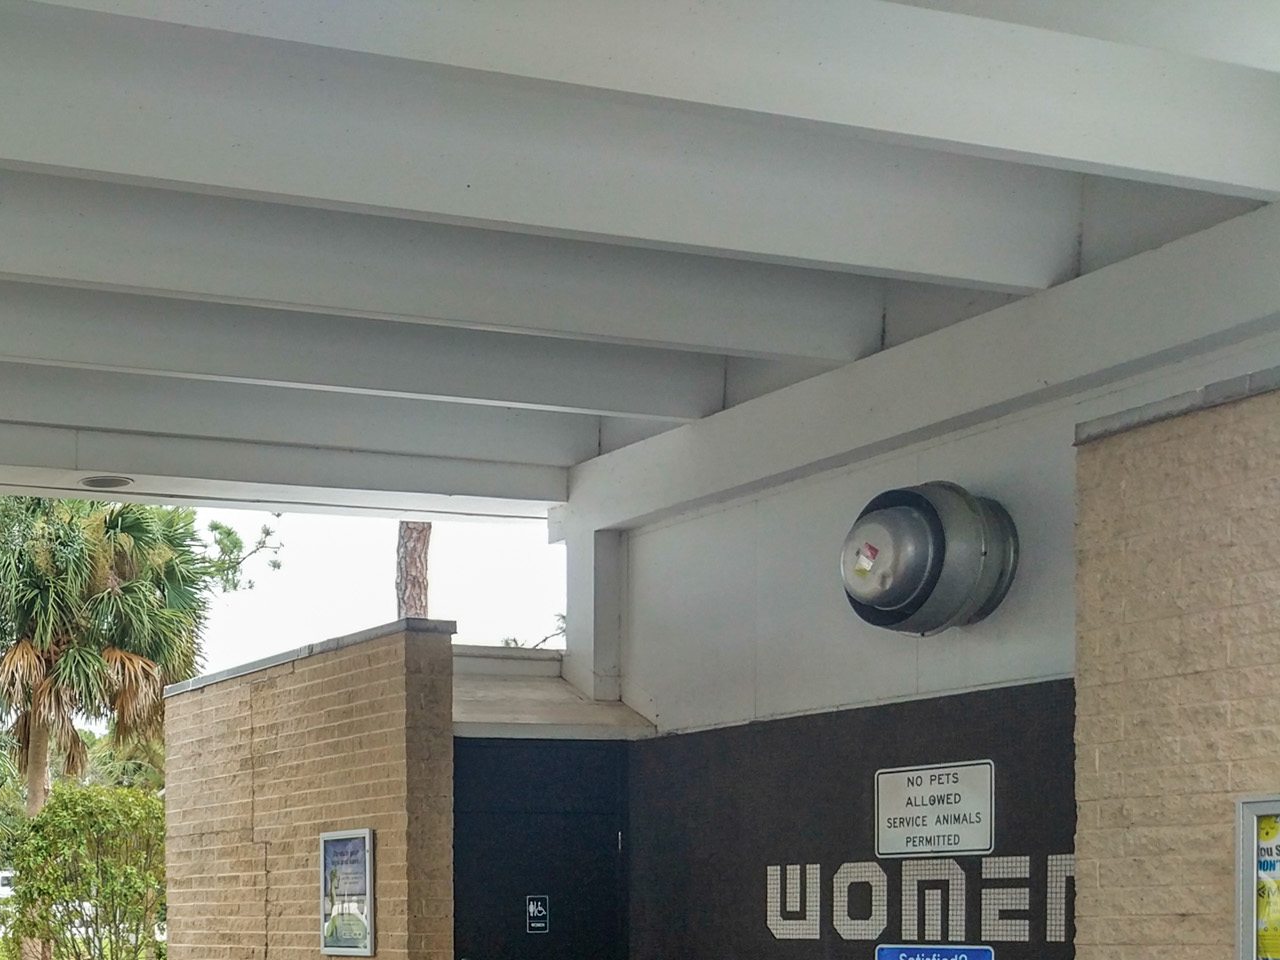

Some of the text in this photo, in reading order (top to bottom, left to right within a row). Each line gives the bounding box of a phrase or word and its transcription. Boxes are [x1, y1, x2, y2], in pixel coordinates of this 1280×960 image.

[907, 772, 959, 787] NO PETS
[905, 793, 962, 808] ALLOWED
[886, 812, 982, 829] SERVICE ANIMALS
[905, 834, 961, 847] PERMITTED
